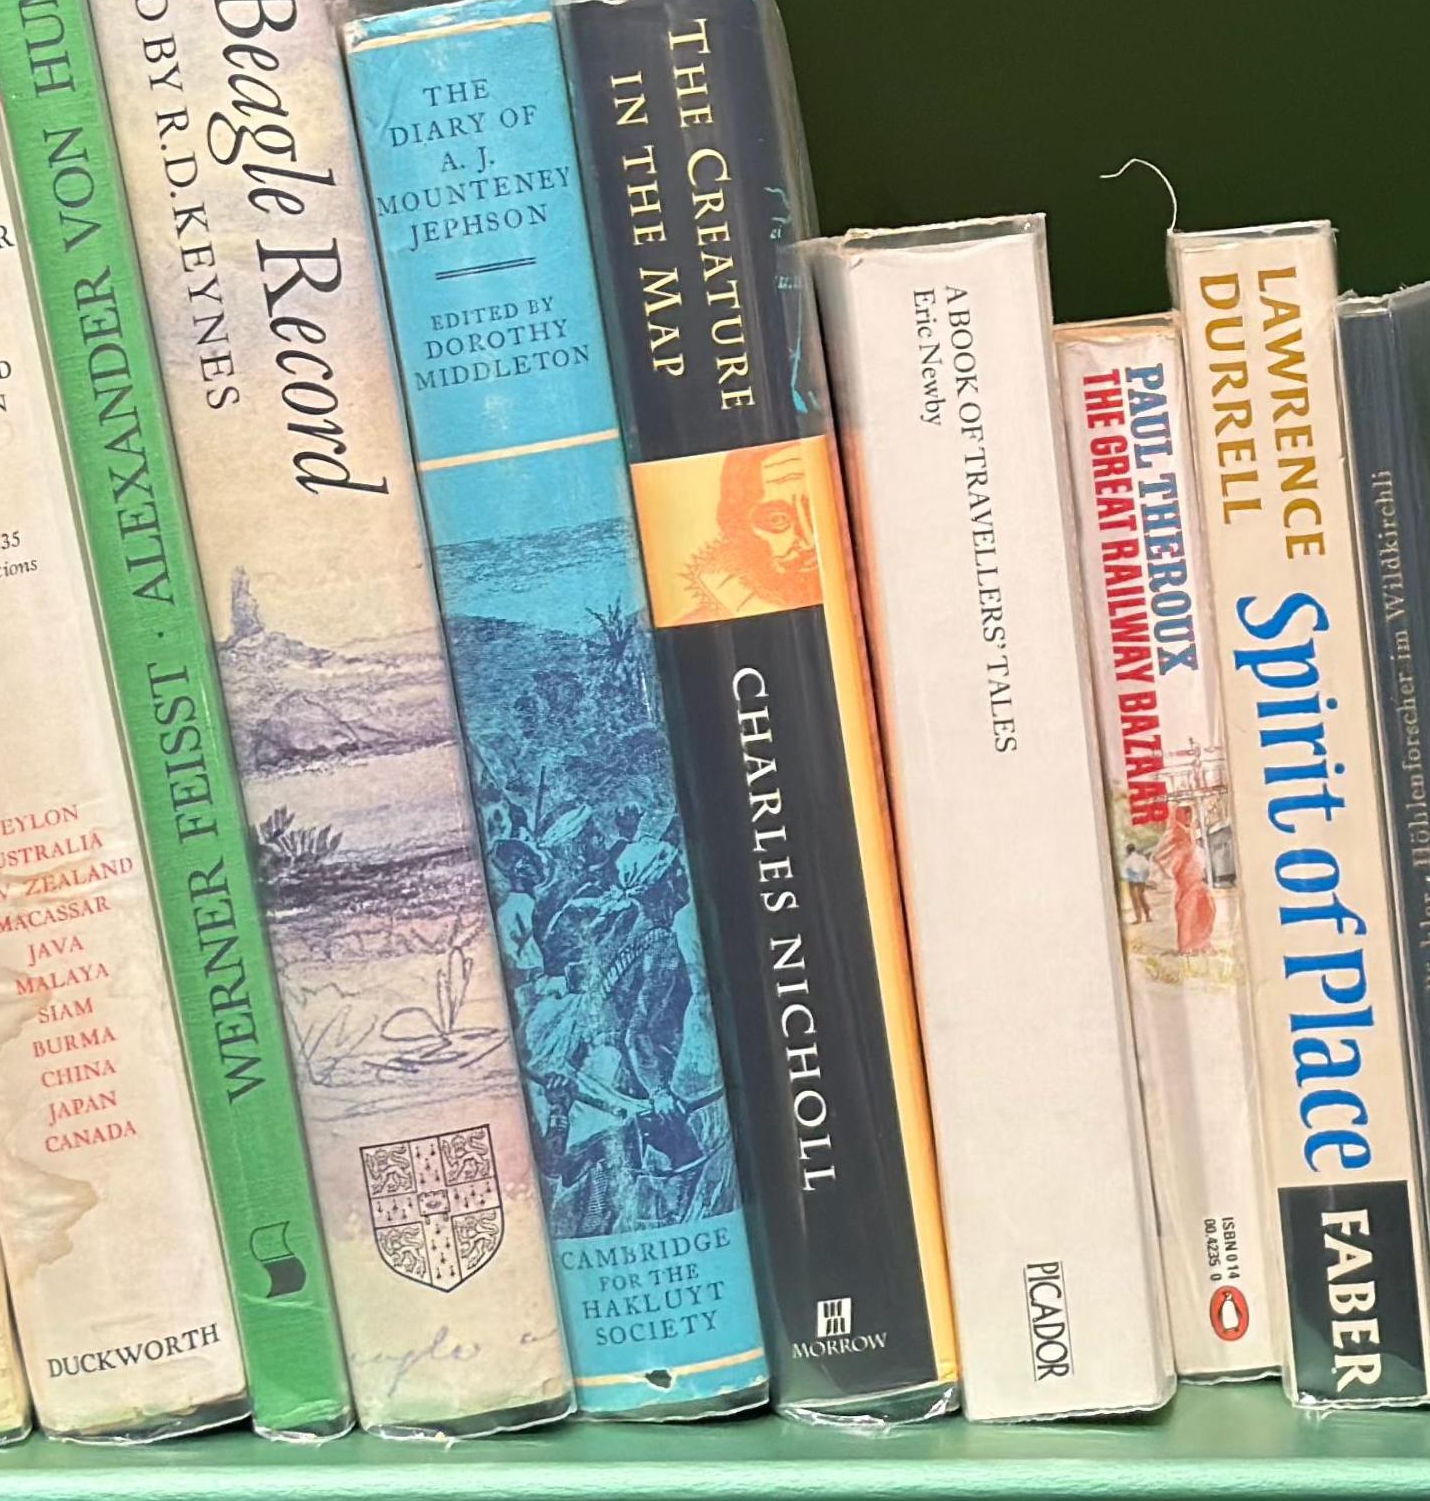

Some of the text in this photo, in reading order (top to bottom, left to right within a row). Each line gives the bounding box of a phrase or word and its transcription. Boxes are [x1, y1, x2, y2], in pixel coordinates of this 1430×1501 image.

[141, 38, 185, 92] BY
[422, 78, 490, 108] THE
[391, 105, 538, 148] DIARY OF
[441, 147, 495, 173] A. J.
[42, 127, 102, 253] VON
[376, 166, 571, 216] MOUNTENEY
[410, 204, 548, 251] JEPHSON
[610, 71, 684, 377] IN THE MAP
[669, 18, 756, 411] THE CREATURE
[430, 297, 554, 331] EDITED BY
[425, 319, 569, 360] DOROTHY
[913, 288, 948, 427] Eric Newby
[255, 238, 389, 496] Record
[415, 345, 590, 392] MIDDLETON
[1199, 274, 1263, 525] DURRELL
[1258, 266, 1325, 561] LAWRENCE
[73, 265, 174, 607] ALEXANDER
[1, 531, 21, 551] 35
[945, 284, 1017, 754] A BOOK OF TALES
[1125, 363, 1198, 676] PAUL THEROUX
[1371, 469, 1405, 624] Wildkirchli
[1082, 368, 1171, 825] THE GREAT RAILWAY BAZAAR
[1391, 629, 1408, 662] im
[146, 663, 219, 857] FEISST
[24, 855, 134, 897] ZEALAND
[1234, 591, 1375, 1173] Spirit of Place
[28, 935, 85, 967] JAVA
[731, 665, 837, 1191] CHARLES NICHOLL
[15, 963, 110, 995] MALAYA
[187, 855, 265, 1104] WERNER
[38, 997, 94, 1024] SIAM
[32, 1027, 116, 1058] BURMA
[41, 1061, 116, 1087] CHINA
[48, 1091, 118, 1127] JAPAN
[44, 1120, 138, 1153] CANADA
[561, 1229, 731, 1272] CAMBRIDGE
[583, 1281, 725, 1320] HAKLUYT
[600, 1264, 699, 1292] FOR THE
[1321, 1209, 1382, 1392] FABER
[595, 1312, 719, 1346] SOCIETY
[791, 1331, 887, 1359] MORROW
[1026, 1262, 1070, 1381] PICADOR
[48, 1323, 220, 1379] DUCKWORTH
